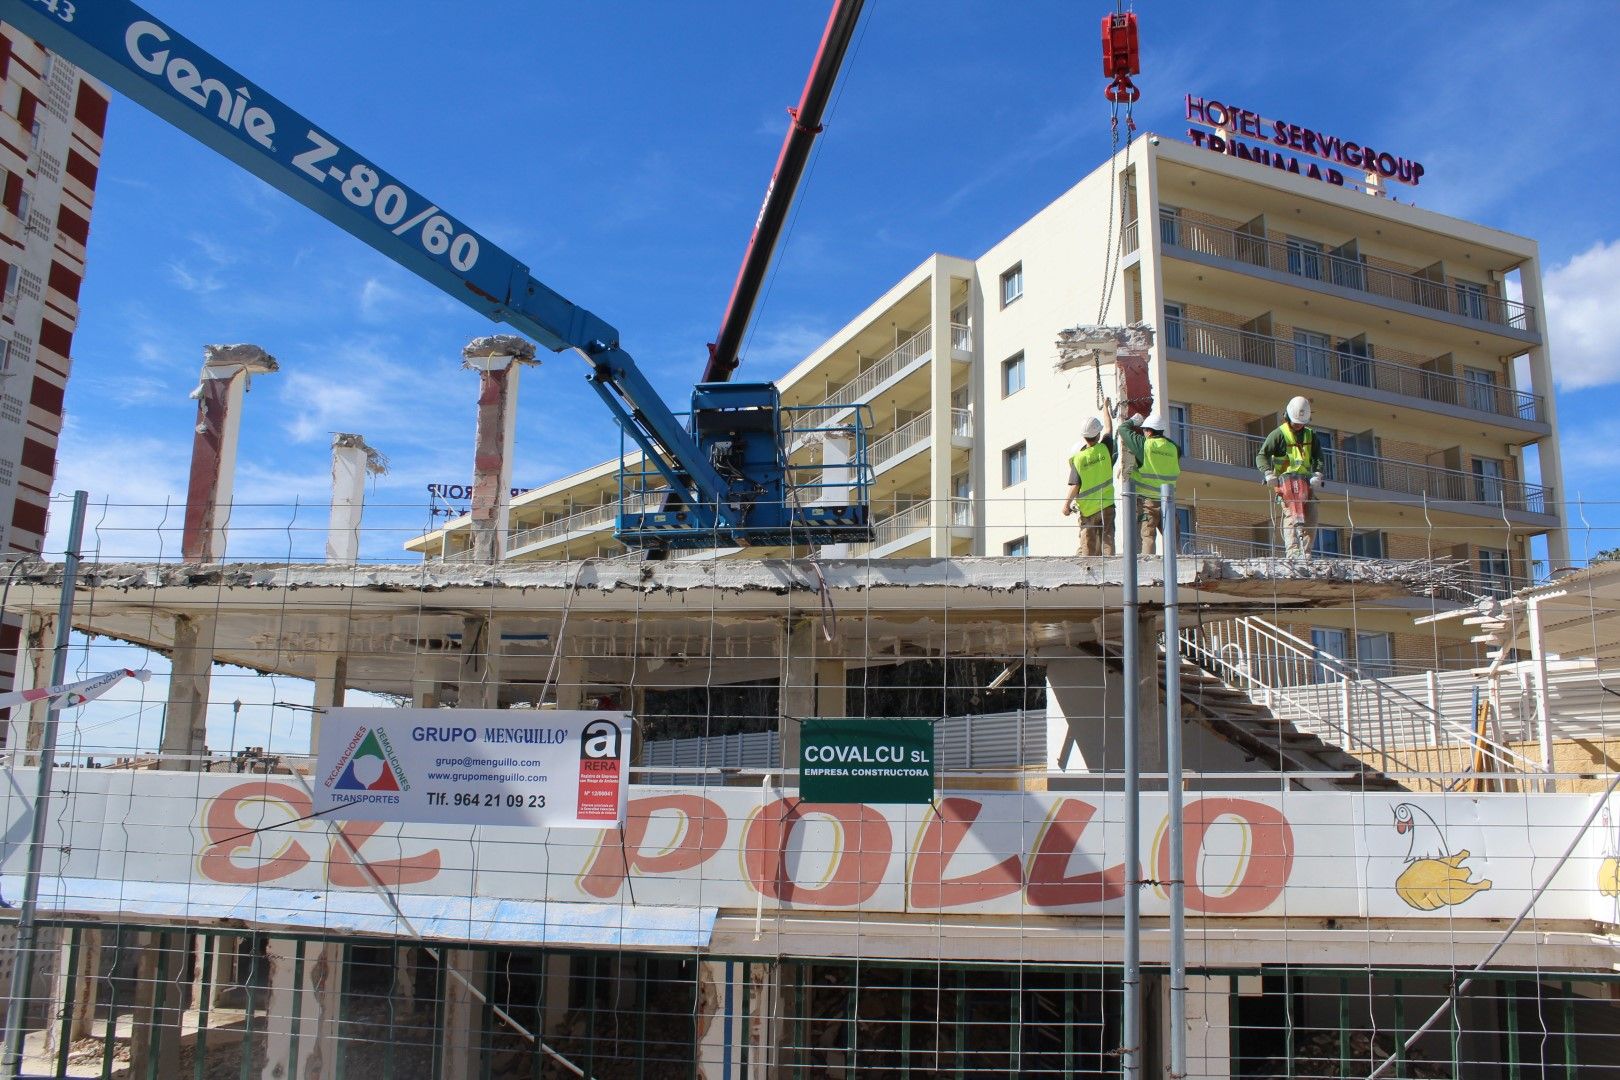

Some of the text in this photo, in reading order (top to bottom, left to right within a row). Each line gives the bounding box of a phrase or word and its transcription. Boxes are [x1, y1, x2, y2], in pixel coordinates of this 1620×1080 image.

[125, 20, 480, 272] Genie Z-80/60
[1184, 93, 1425, 186] HOTEL SERVIGROUP
[412, 726, 477, 743] GRUPO
[324, 725, 367, 788] EXCAVACIONES
[377, 726, 411, 792] DEMOLICIONES
[435, 757, 541, 768] grupo@menguillo.com
[804, 745, 930, 763] COVALCU SL
[584, 761, 617, 771] RERA
[804, 768, 930, 777] EMPRESA CONSTRUCTORA
[428, 772, 548, 783] www.grupomenguillo.com
[331, 793, 400, 804] TRANSPORTES
[427, 792, 546, 808] Tlf. 964 21 09 23
[574, 794, 1295, 915] POLLO
